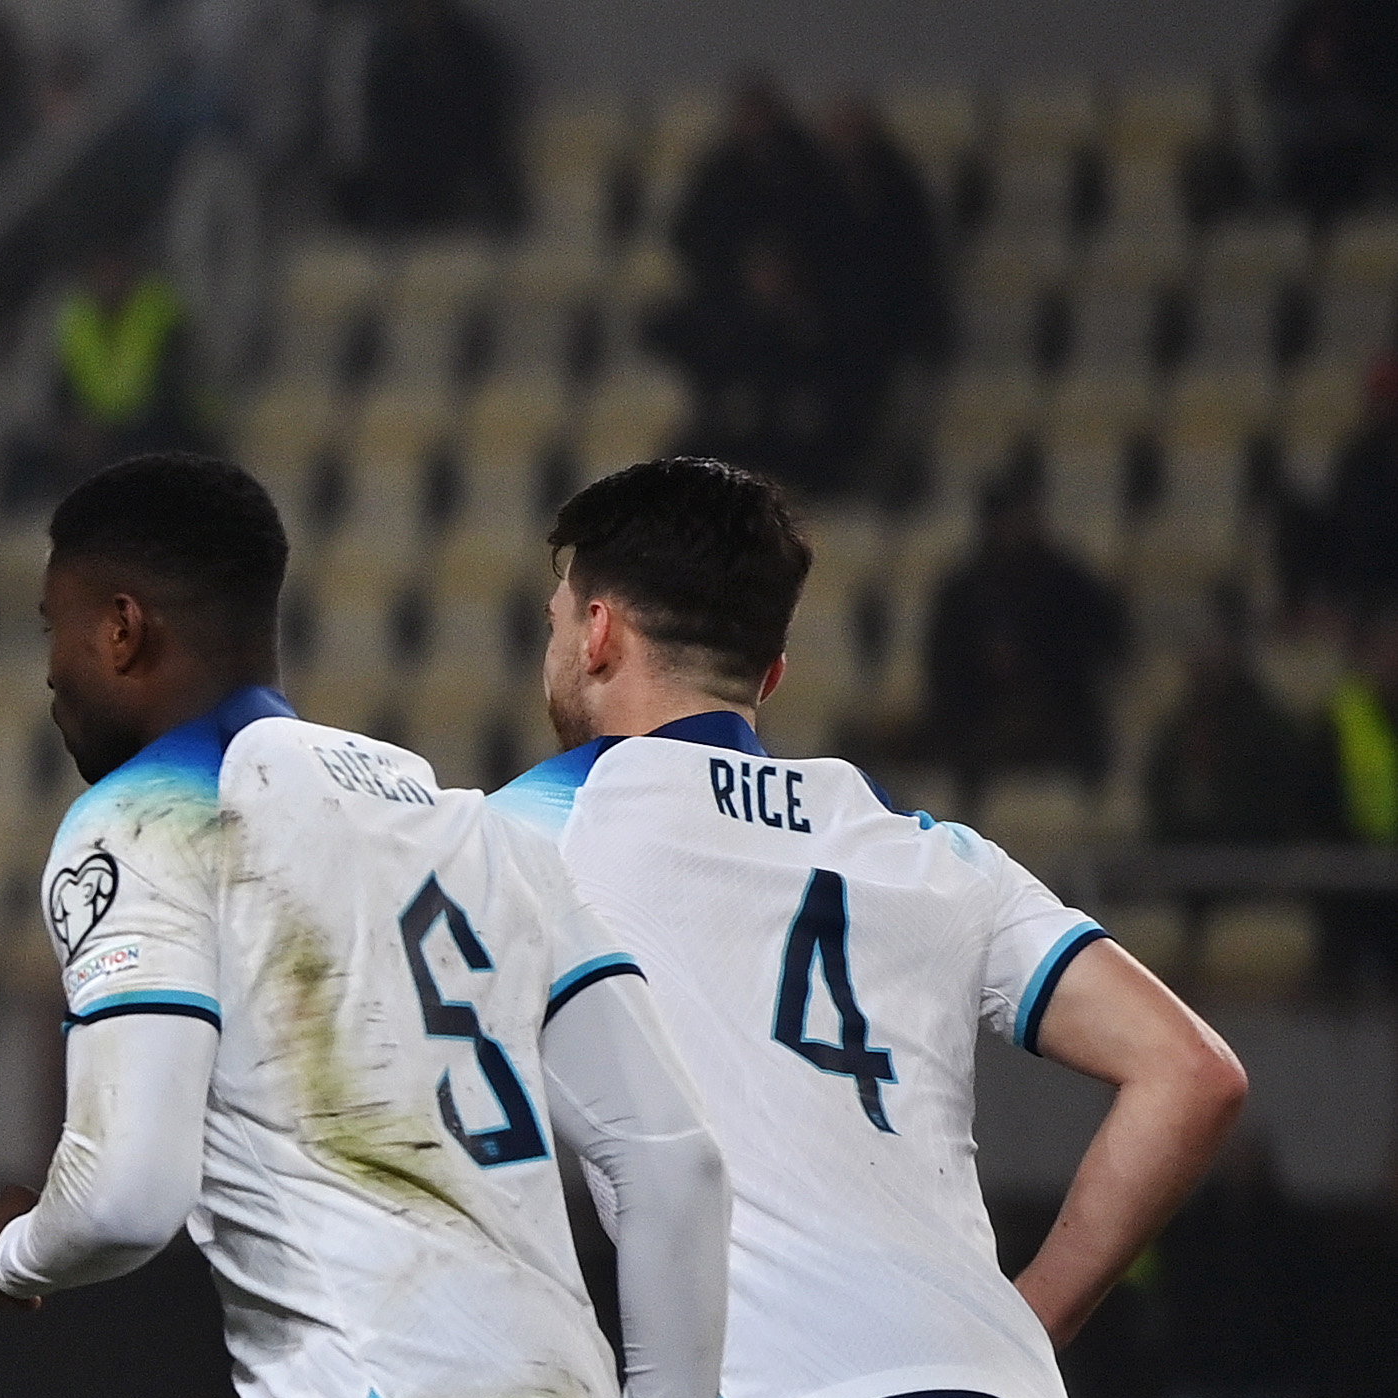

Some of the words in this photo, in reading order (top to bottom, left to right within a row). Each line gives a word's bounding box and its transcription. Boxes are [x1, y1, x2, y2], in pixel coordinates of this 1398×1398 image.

[709, 757, 812, 834] RICE
[398, 869, 552, 1170] 5
[770, 866, 901, 1136] 4
